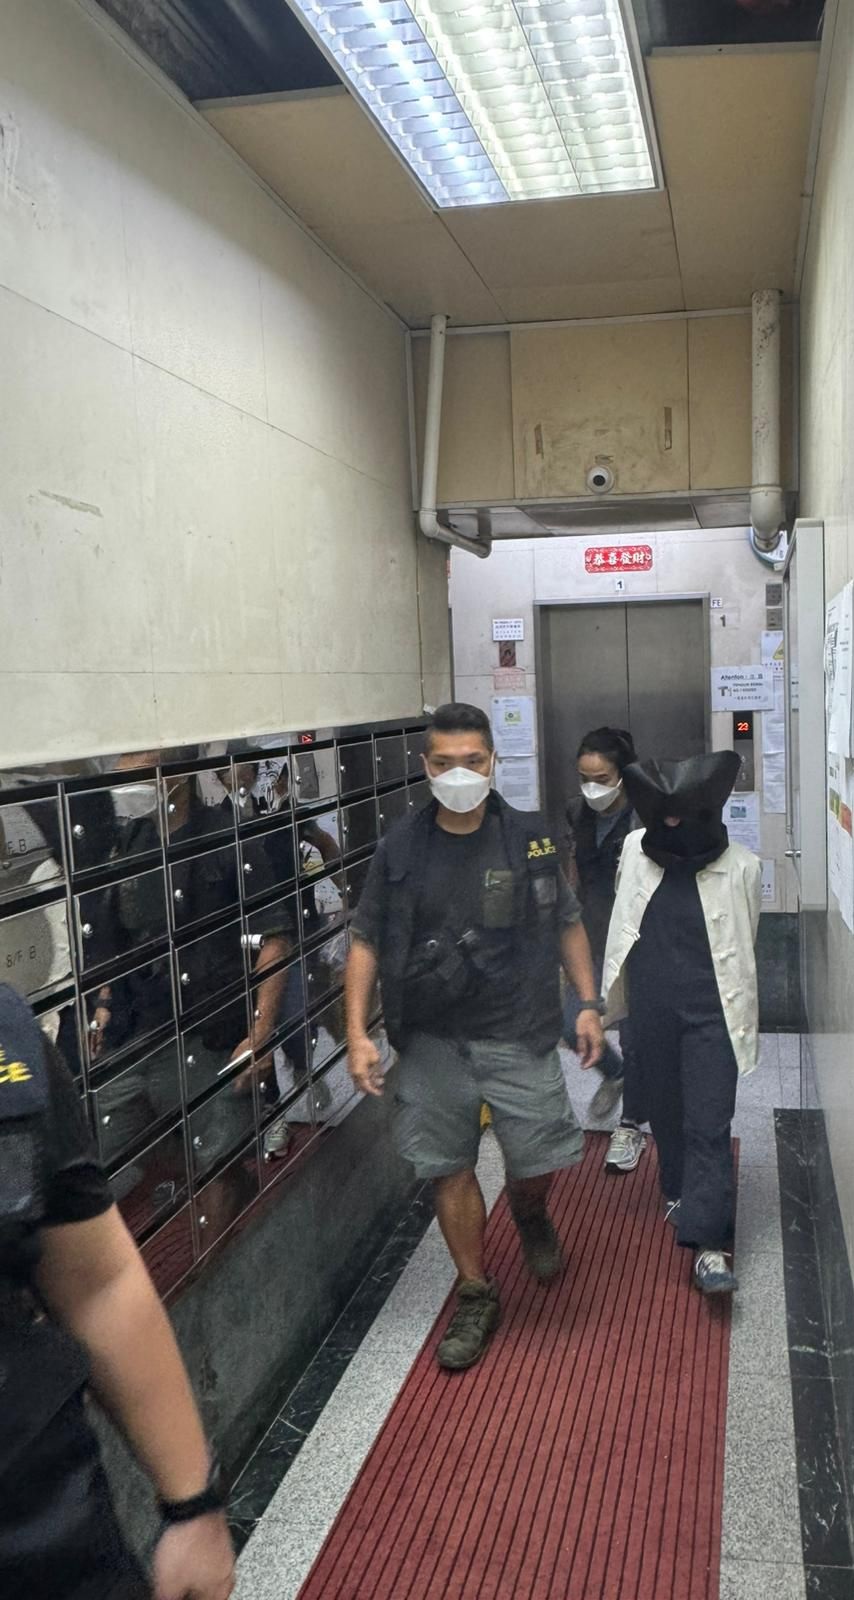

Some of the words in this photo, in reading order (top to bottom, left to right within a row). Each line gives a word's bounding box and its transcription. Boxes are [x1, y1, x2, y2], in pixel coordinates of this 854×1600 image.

[592, 551, 645, 566] 恭喜發財
[616, 580, 623, 589] 1
[719, 614, 726, 627] 1
[737, 722, 749, 731] 23
[18, 838, 27, 852] B
[527, 845, 556, 859] POLICE
[29, 945, 37, 960] B
